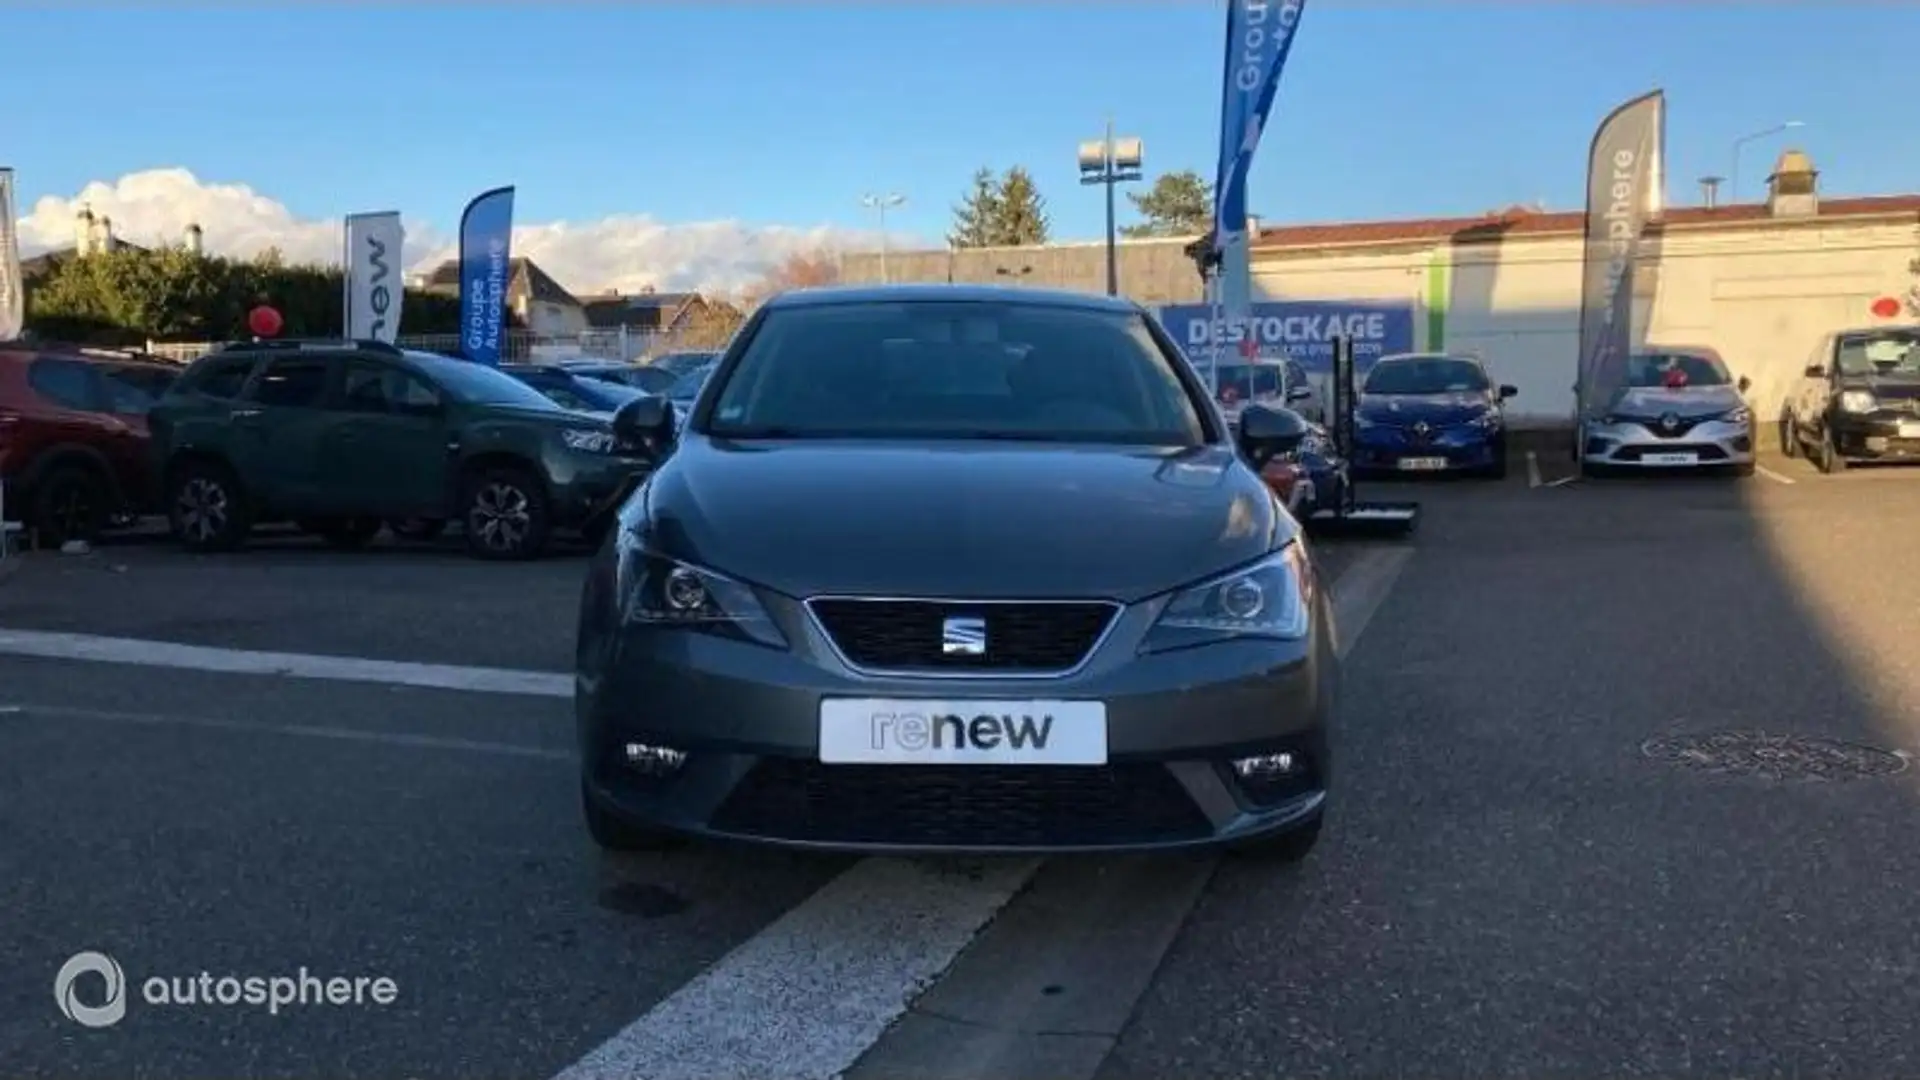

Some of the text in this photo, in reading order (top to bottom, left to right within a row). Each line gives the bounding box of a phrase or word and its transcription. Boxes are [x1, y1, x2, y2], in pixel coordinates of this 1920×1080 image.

[468, 278, 486, 350] Groupe
[1188, 313, 1385, 345] DESTOCKAGE
[870, 713, 1053, 750] renew
